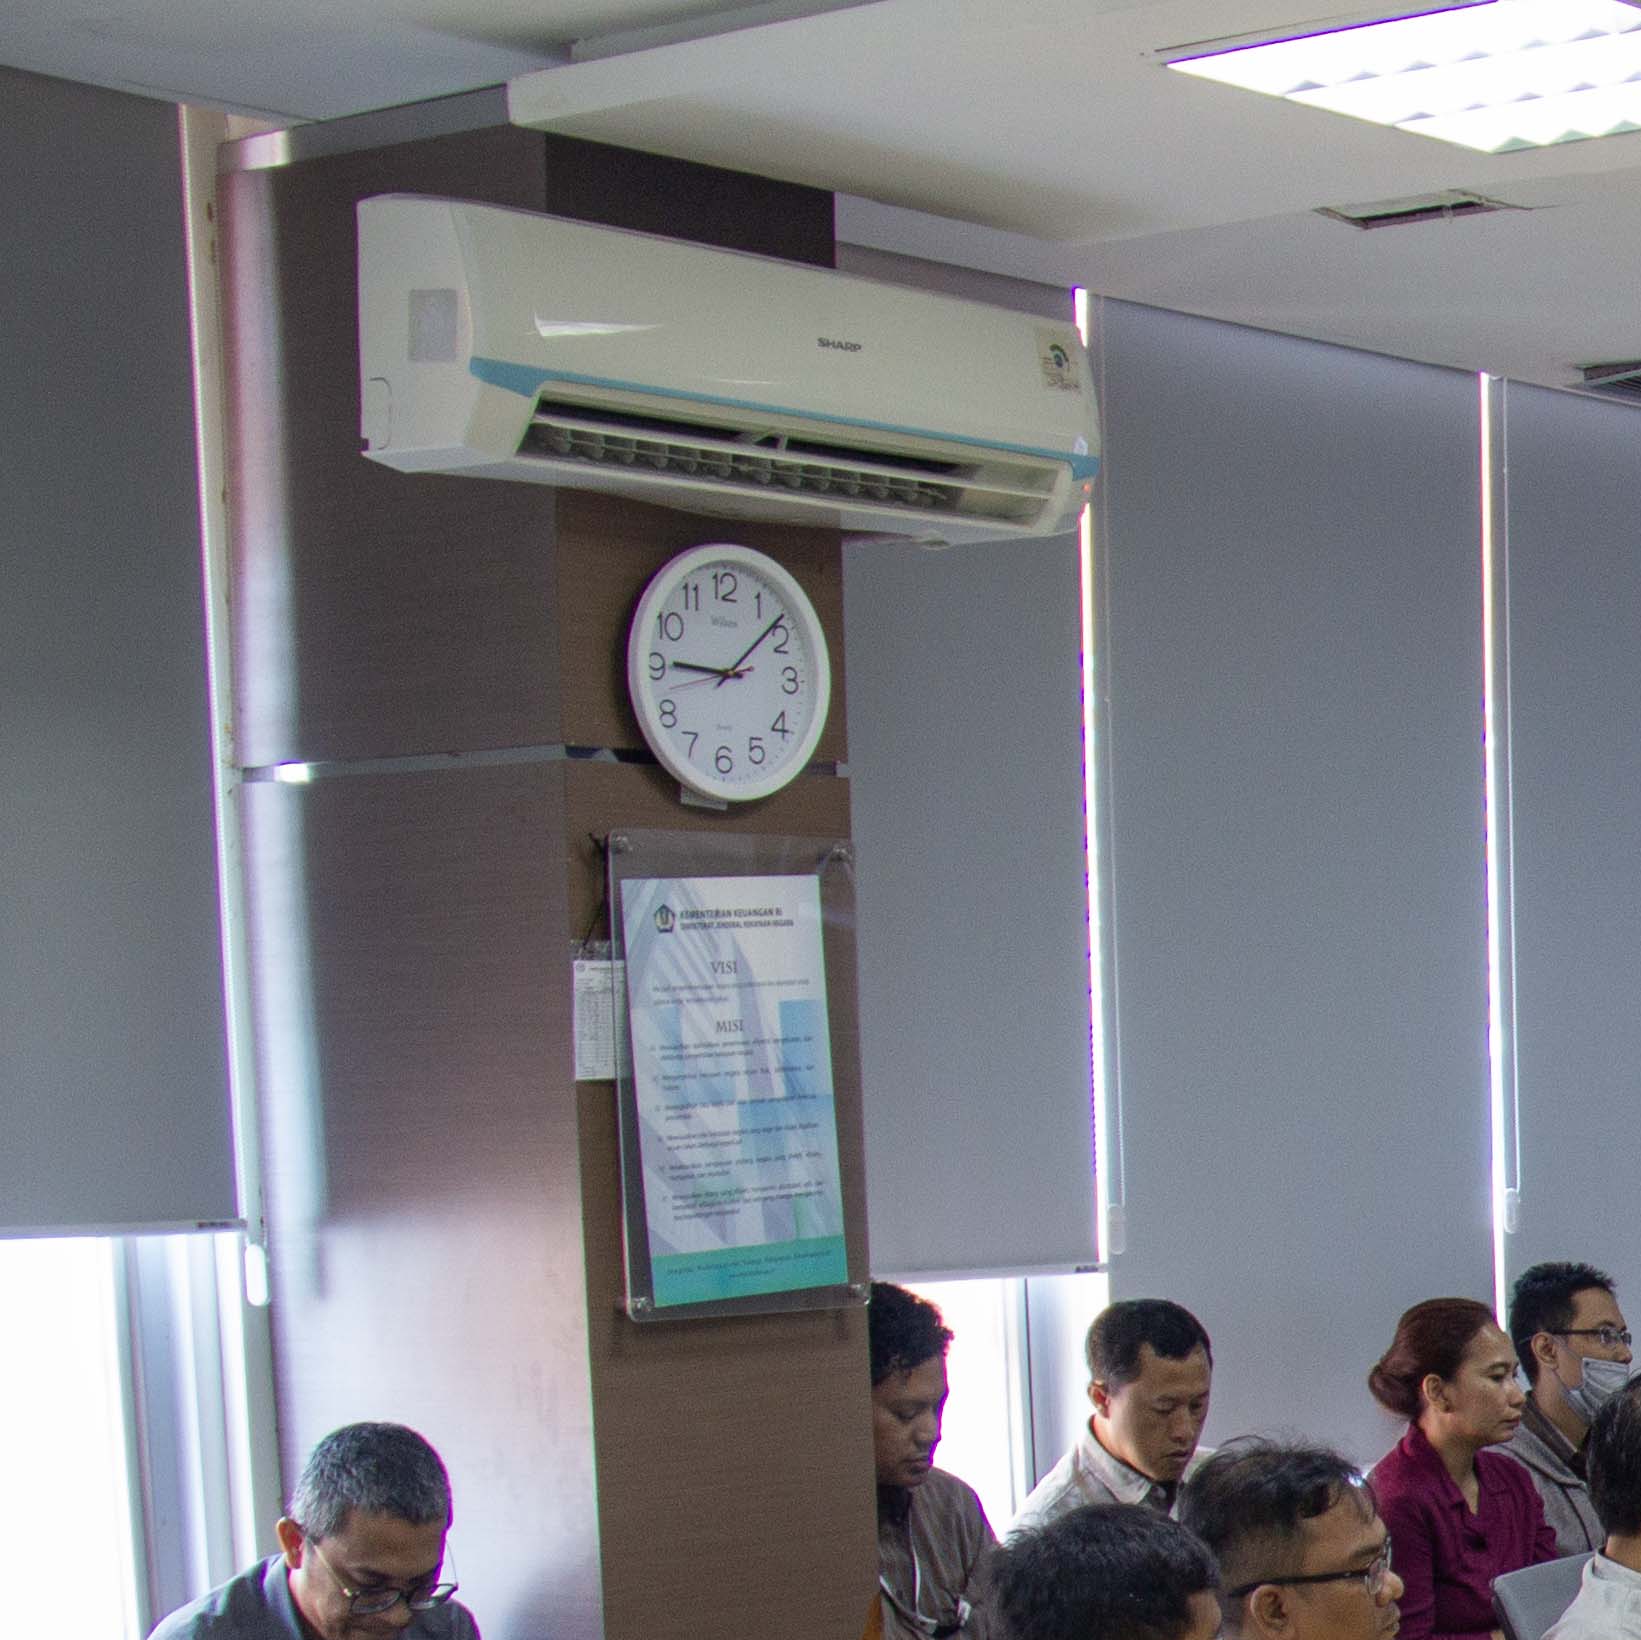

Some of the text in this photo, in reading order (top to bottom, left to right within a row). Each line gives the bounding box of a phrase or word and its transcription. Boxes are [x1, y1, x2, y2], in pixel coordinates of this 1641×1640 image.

[817, 336, 862, 352] SHARP
[682, 583, 699, 611] 11
[712, 572, 737, 603] 12
[755, 592, 762, 619] 1
[657, 612, 684, 641] 10
[772, 624, 790, 654] 2
[649, 652, 666, 680] 9
[782, 666, 799, 695] 3
[659, 699, 678, 728] 8
[771, 711, 790, 740] 4
[682, 731, 698, 758] 7
[749, 736, 766, 764] 5
[716, 745, 733, 774] 6
[711, 961, 738, 974] VISI
[716, 1019, 744, 1032] MISI
